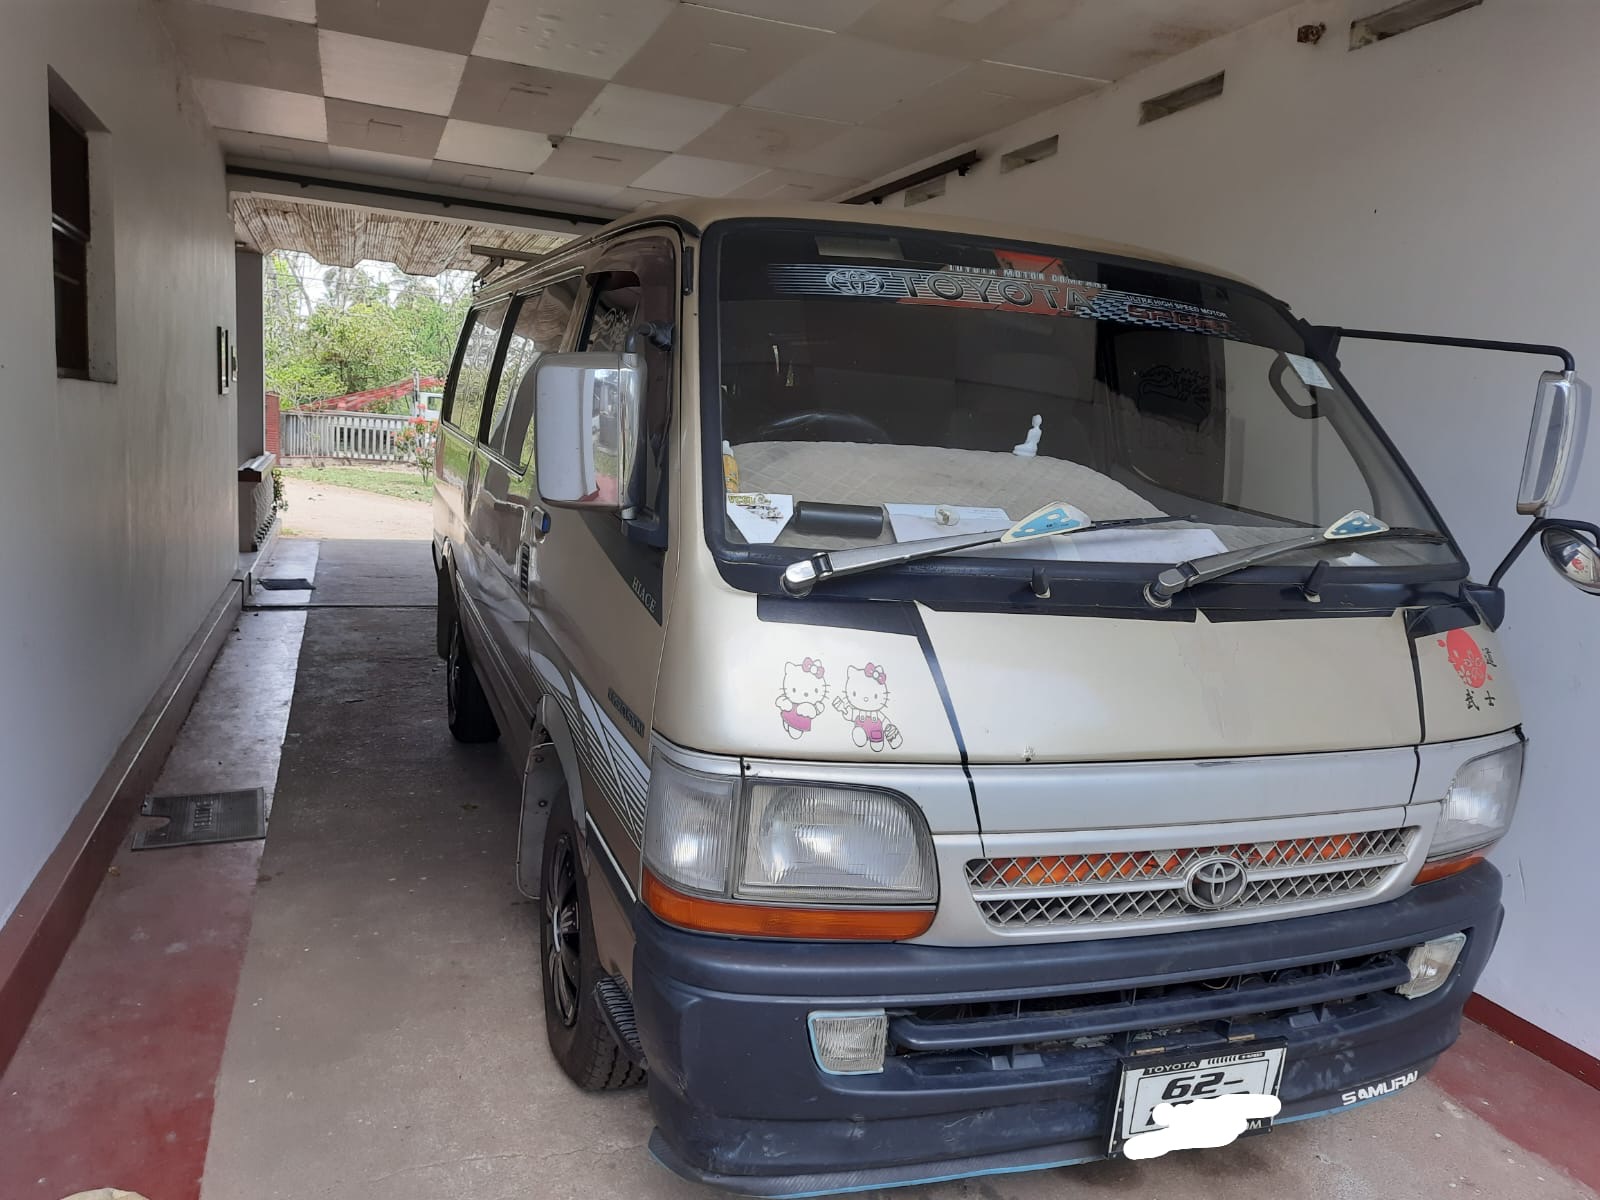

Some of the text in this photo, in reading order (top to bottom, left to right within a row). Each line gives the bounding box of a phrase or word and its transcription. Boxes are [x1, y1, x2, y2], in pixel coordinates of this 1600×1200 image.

[1003, 268, 1045, 281] MOTOR
[891, 271, 1098, 313] TOYOTA
[1126, 295, 1228, 319] ULTRA HIGH SPEED MOTOR
[632, 577, 657, 613] HIACE
[1148, 1061, 1198, 1074] TOYOTA
[1161, 1071, 1244, 1100] 62-
[1341, 1070, 1419, 1106] SAMURAI
